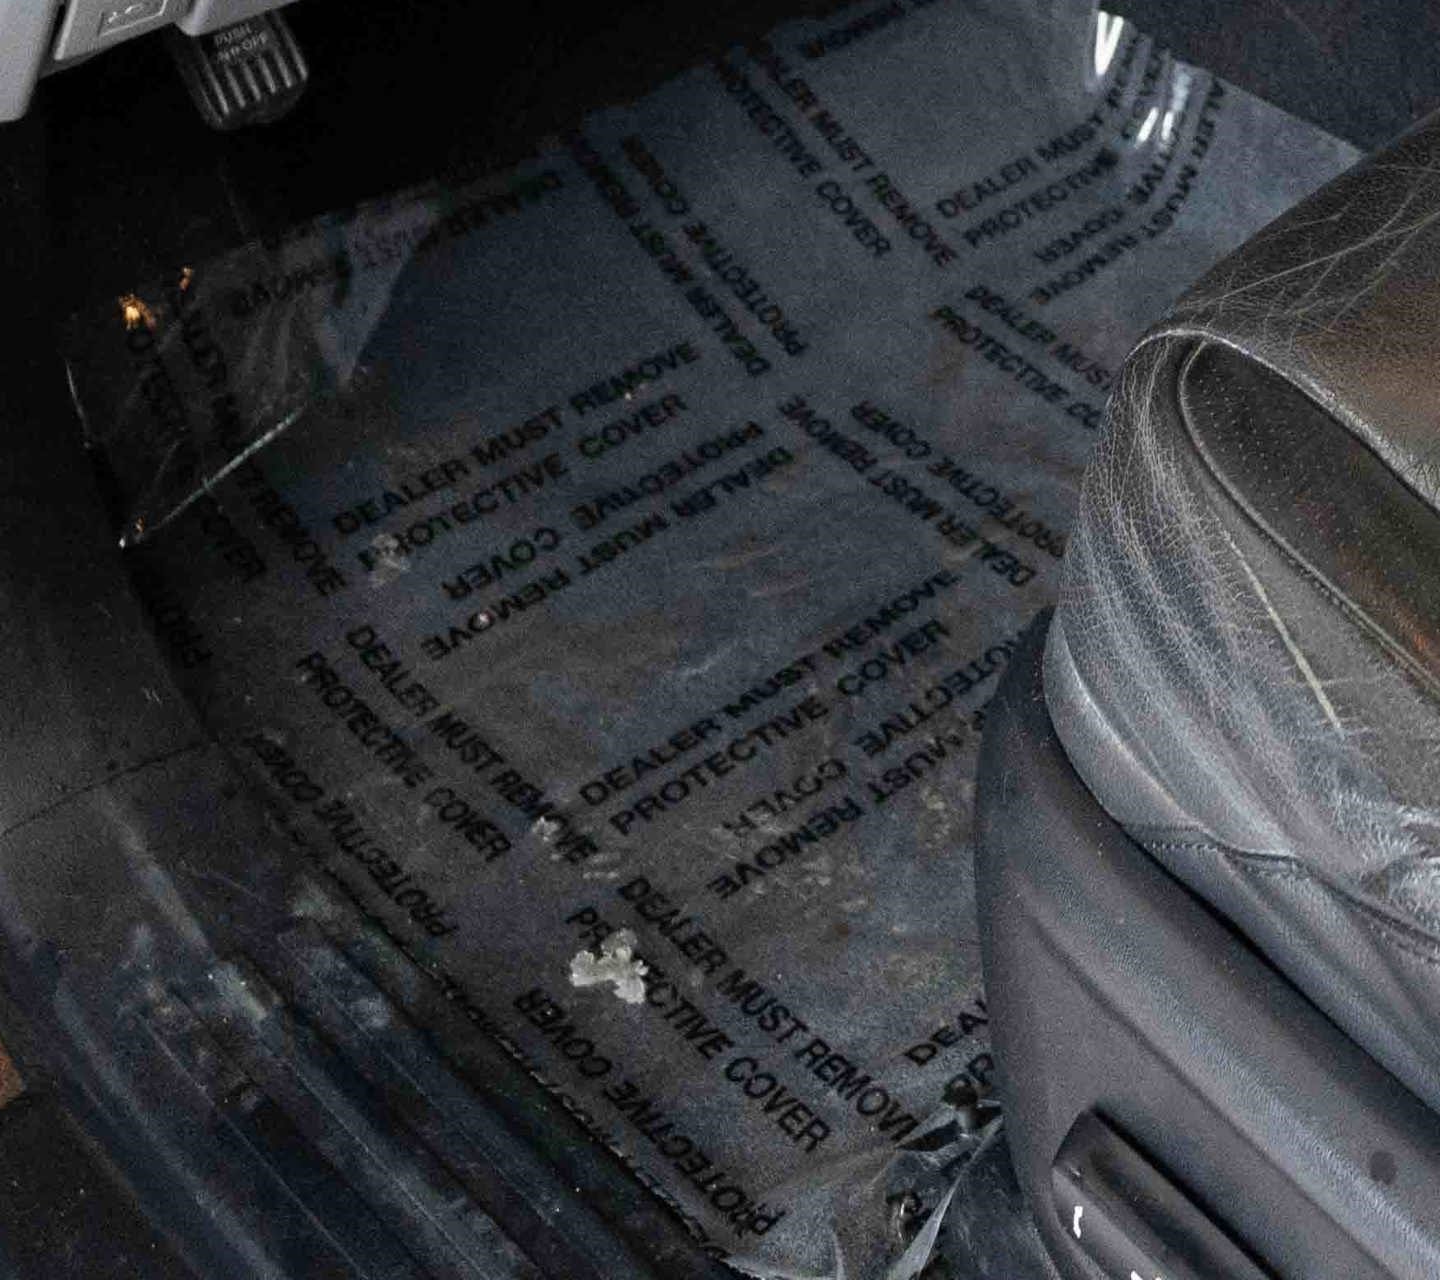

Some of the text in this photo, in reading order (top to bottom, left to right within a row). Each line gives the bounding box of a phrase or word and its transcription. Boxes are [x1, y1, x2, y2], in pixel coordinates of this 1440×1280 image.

[810, 109, 876, 173] MUST
[865, 171, 960, 268] REMOVE
[816, 178, 893, 260] COVER
[934, 156, 1038, 222] DEALER
[682, 220, 809, 357] PROTECTIVE
[686, 287, 772, 378] DEALER
[926, 305, 1071, 404] PROTECTIVE
[963, 285, 1058, 345] DEALER
[331, 341, 703, 536] DEALER MUST REMOVE
[357, 393, 691, 575] POTECTIVE COVER
[440, 420, 767, 603] PROTECTIVE COVER
[866, 468, 944, 523] MUST
[419, 444, 798, 661] DEALER MUST REMOVE
[296, 650, 513, 864] PROTECTIVE COVER
[345, 623, 442, 719] DEALER
[425, 711, 505, 777] MUST
[578, 715, 726, 809] DEALER
[721, 653, 821, 720] MUST
[607, 619, 954, 837] PROTECTIVE COVER
[313, 797, 460, 940] PROTECTIVE
[707, 732, 965, 902] MUST REMOVE
[512, 986, 614, 1081] COVER
[618, 875, 730, 977] DEALER
[717, 967, 811, 1045] MUST
[602, 1079, 788, 1237] PROTECTIVE
[723, 1054, 833, 1153] COVER
